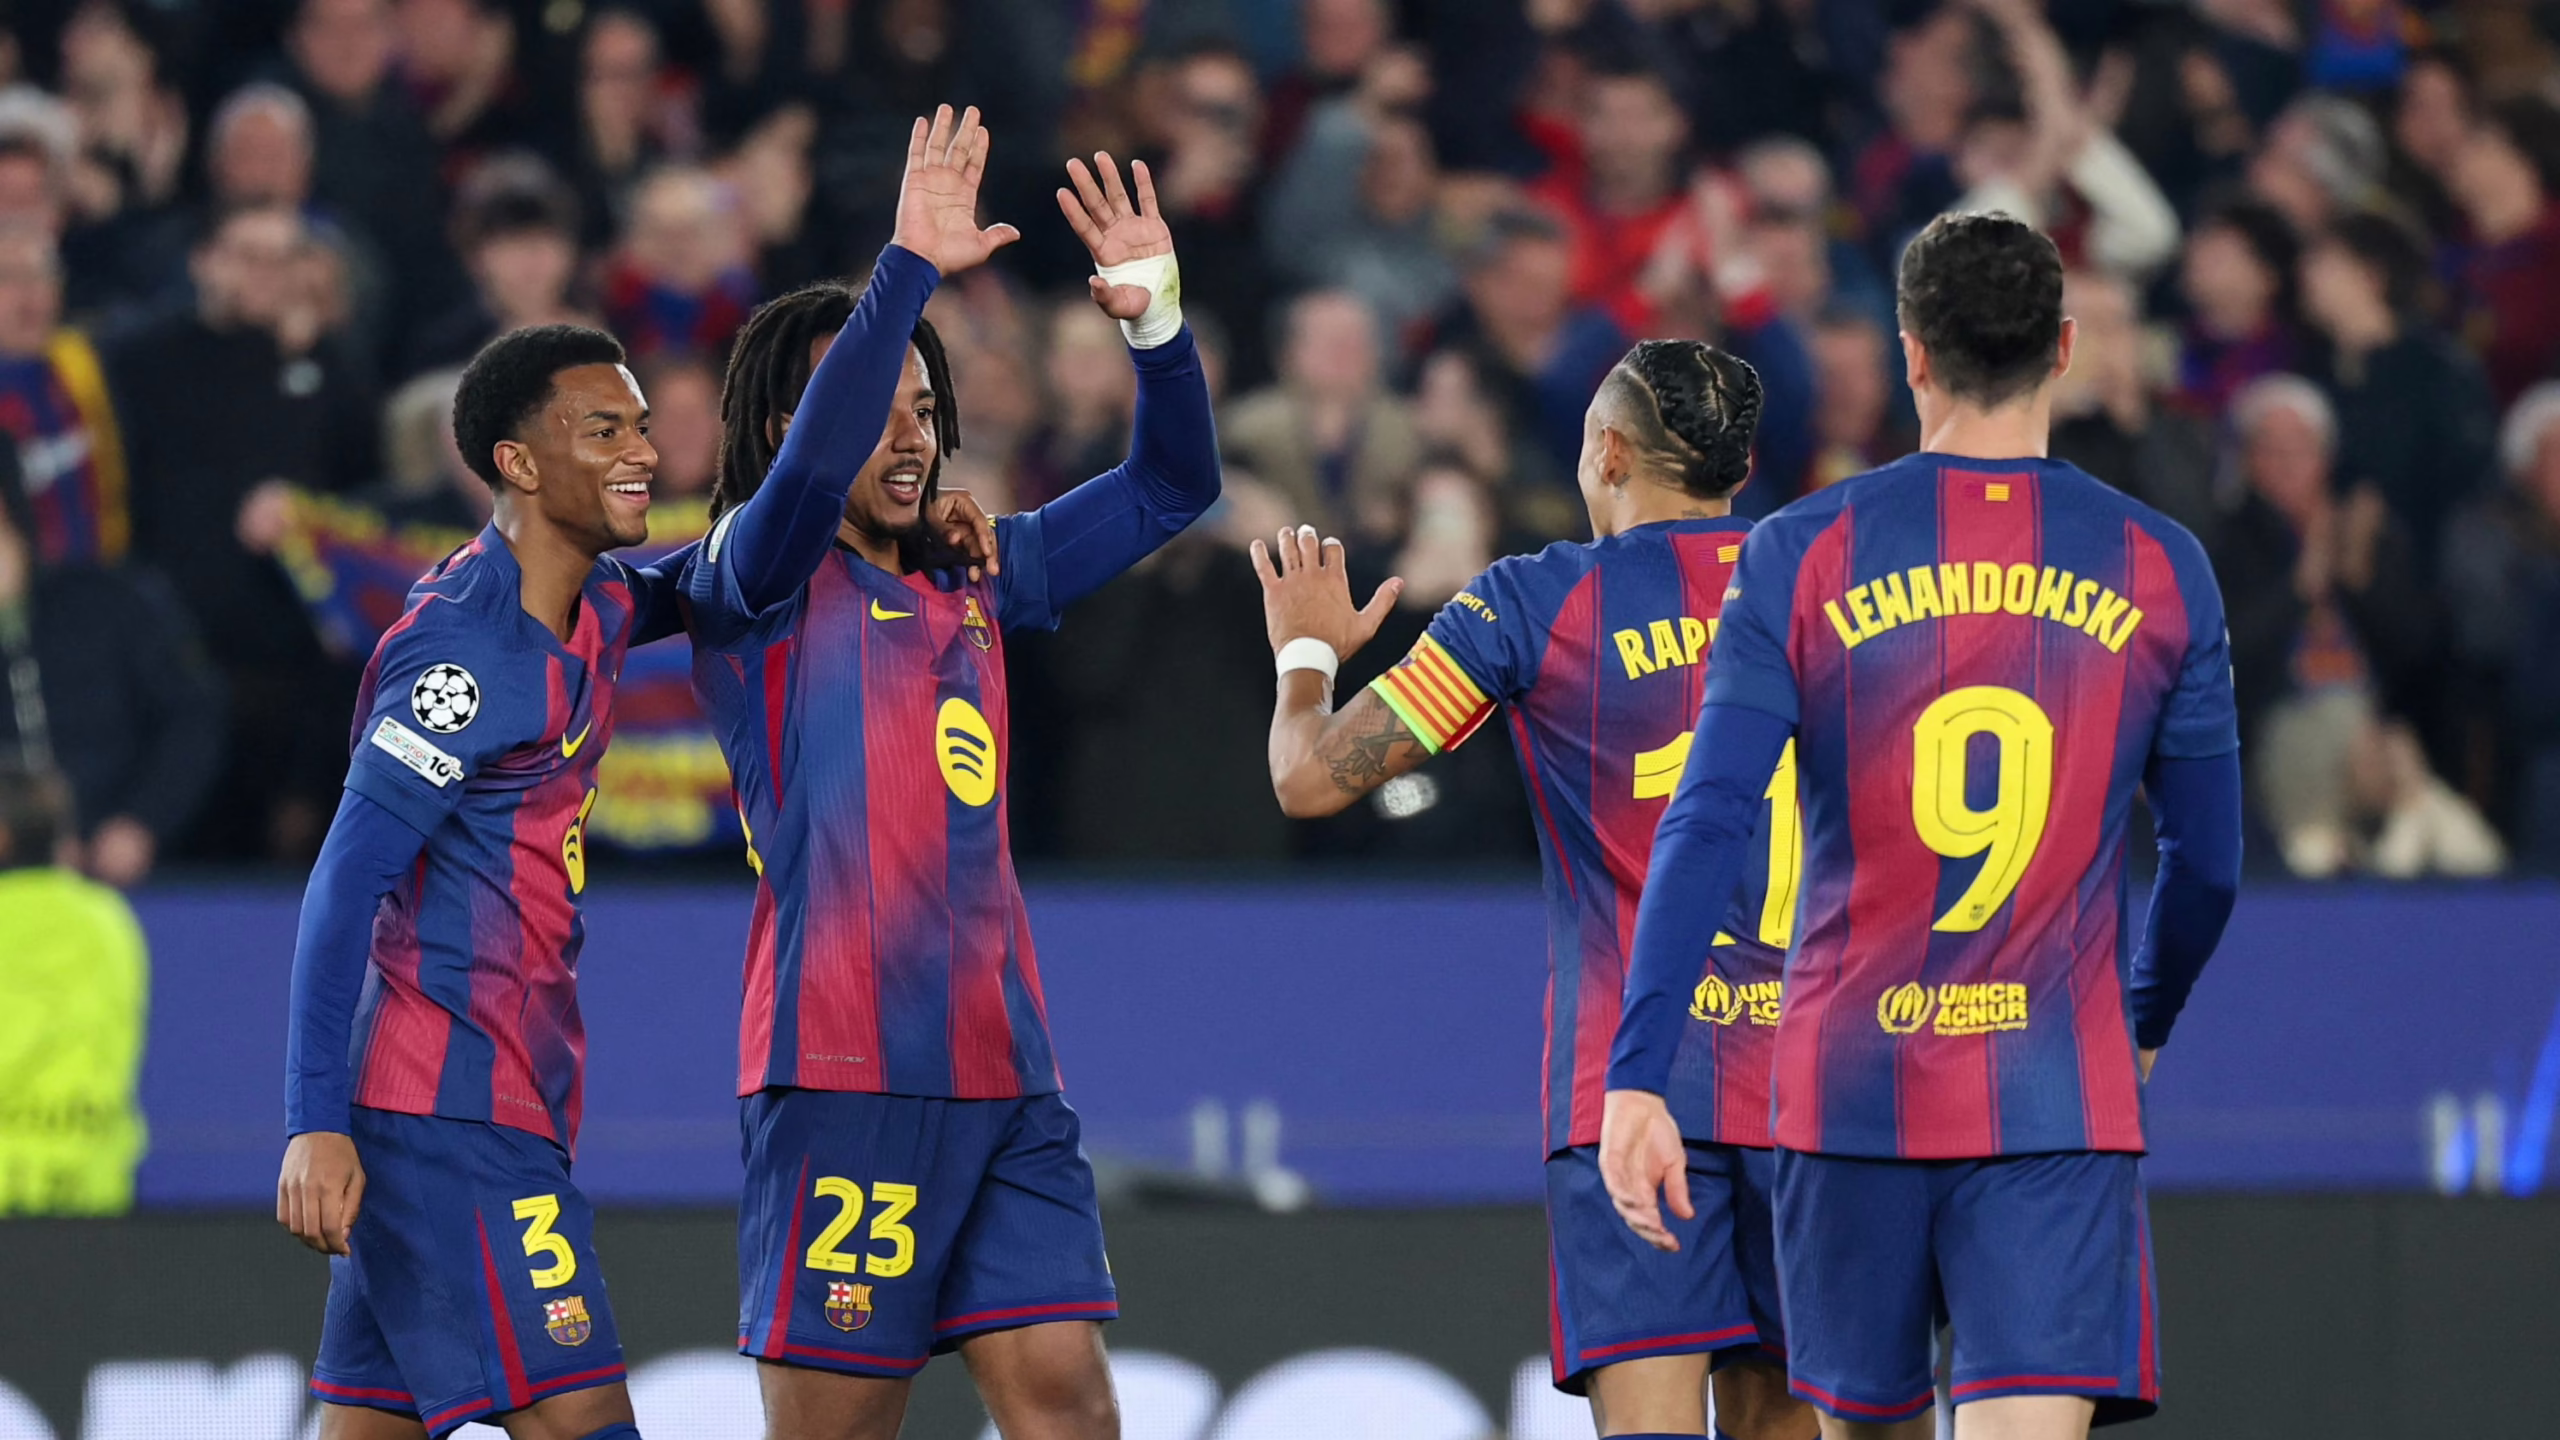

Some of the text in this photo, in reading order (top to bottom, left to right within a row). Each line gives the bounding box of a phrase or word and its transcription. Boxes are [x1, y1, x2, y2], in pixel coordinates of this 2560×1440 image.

[1823, 561, 2144, 654] LEWANDOWSKI
[432, 683, 458, 711] 5
[379, 727, 429, 762] FOUNDATION
[1911, 685, 2054, 932] 9
[1738, 981, 1783, 1002] UN
[1938, 983, 2027, 1006] UNHCR
[1933, 1002, 2028, 1027] ACNUR
[511, 1193, 577, 1289] 3
[806, 1176, 918, 1278] 23
